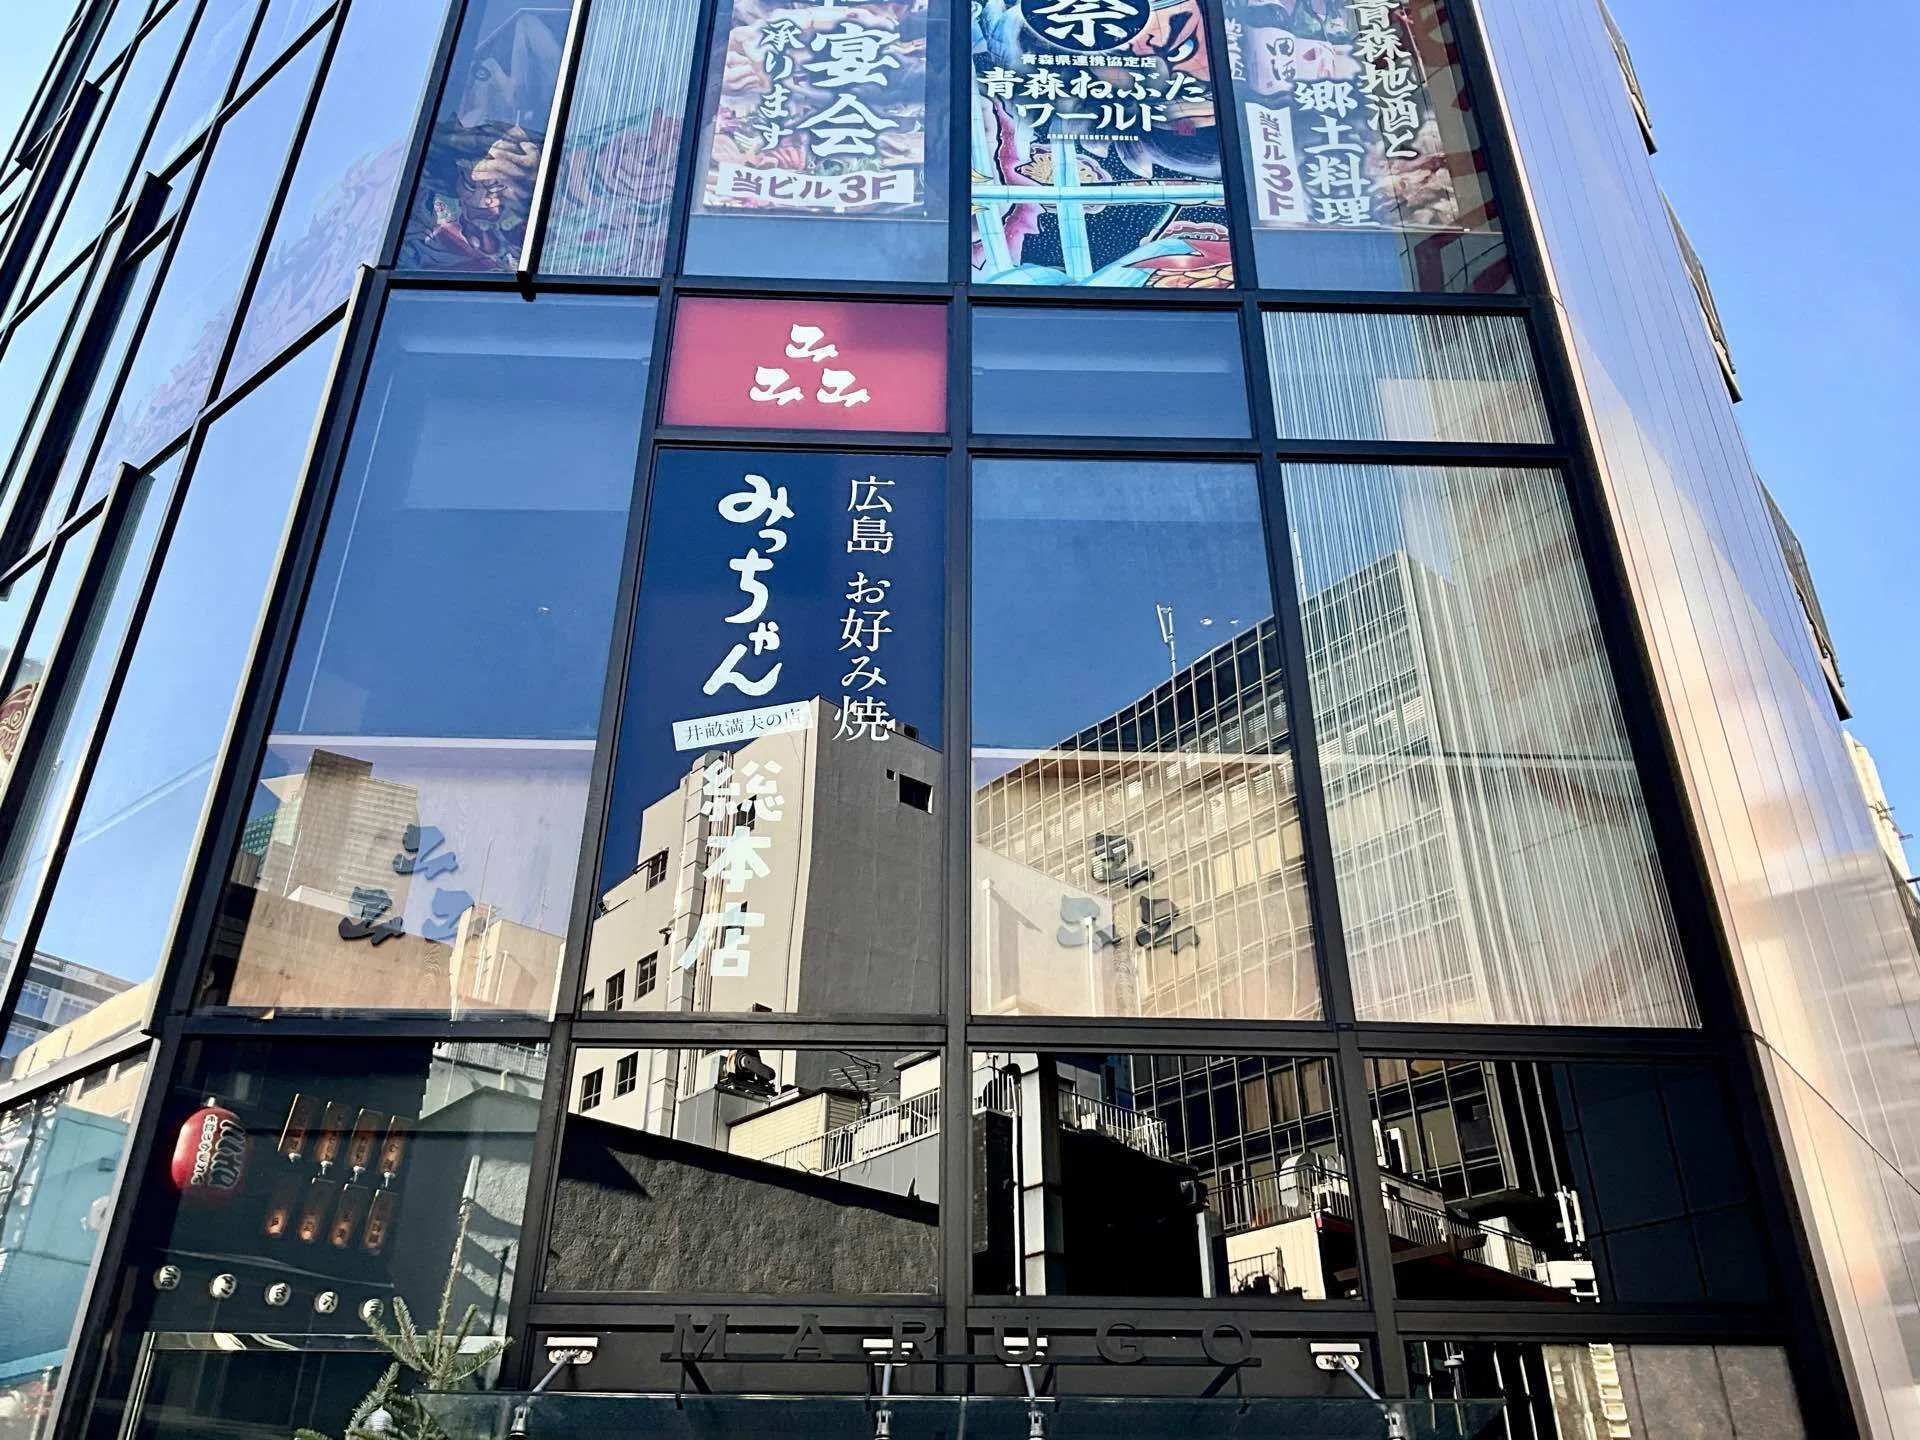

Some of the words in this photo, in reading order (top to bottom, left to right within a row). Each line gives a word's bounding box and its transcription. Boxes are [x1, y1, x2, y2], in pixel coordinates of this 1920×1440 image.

[752, 18, 805, 151] 承ります
[796, 0, 902, 158] 宴会
[977, 66, 1206, 103] 青森ねぶた
[1015, 102, 1171, 132] ワールド
[1020, 53, 1157, 68] 青森県連携協定店
[1344, 0, 1420, 159] 青森地酒と
[731, 169, 898, 204] 当ビル3F
[1258, 111, 1296, 217] 当ビル3F
[1294, 81, 1381, 228] 郷土料理
[846, 475, 896, 554] 広島
[702, 474, 796, 697] みっちゃん
[831, 571, 895, 742] お好み焼
[677, 759, 785, 977] 総本店
[671, 1312, 1256, 1366] MARUGO
